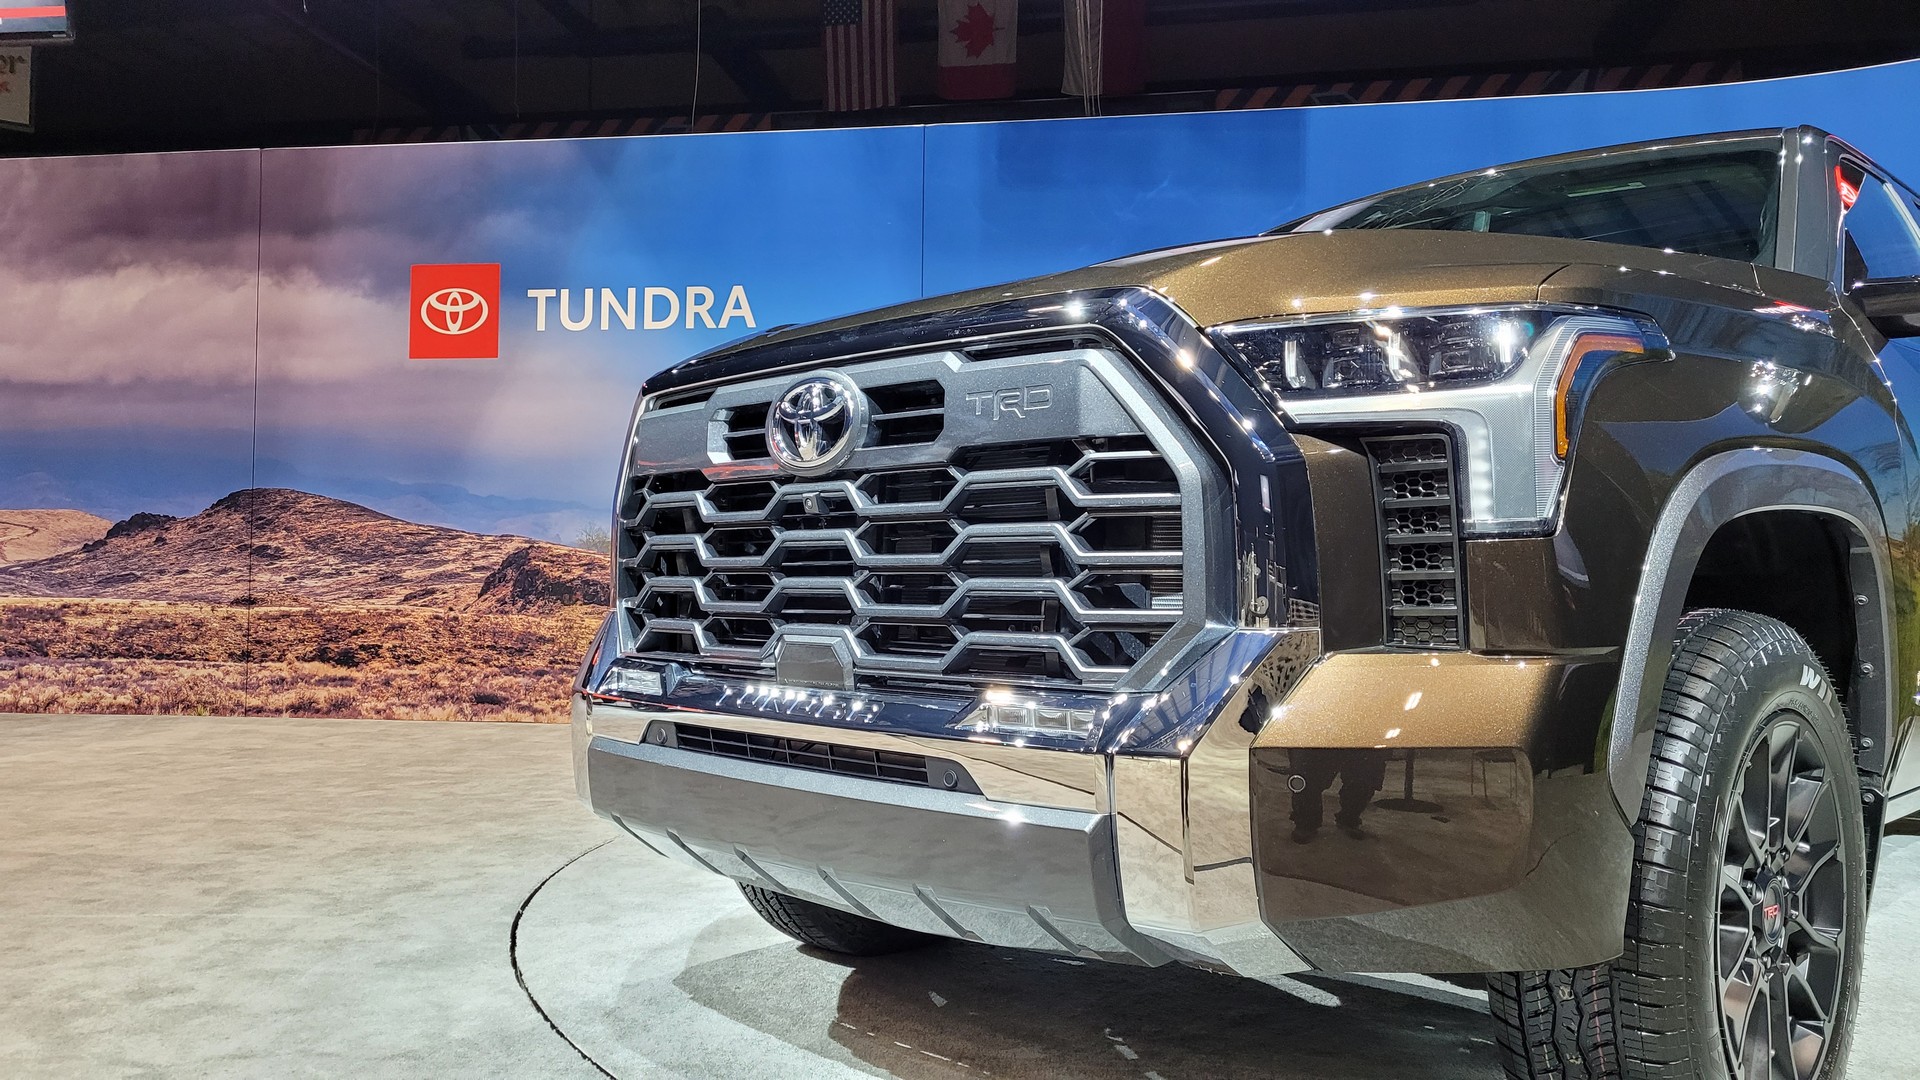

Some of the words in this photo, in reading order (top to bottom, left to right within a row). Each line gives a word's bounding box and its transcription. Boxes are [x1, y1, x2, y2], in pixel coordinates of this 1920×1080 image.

[527, 285, 757, 332] TUNDRA
[965, 383, 1053, 421] TRD
[1763, 903, 1780, 920] TRD
